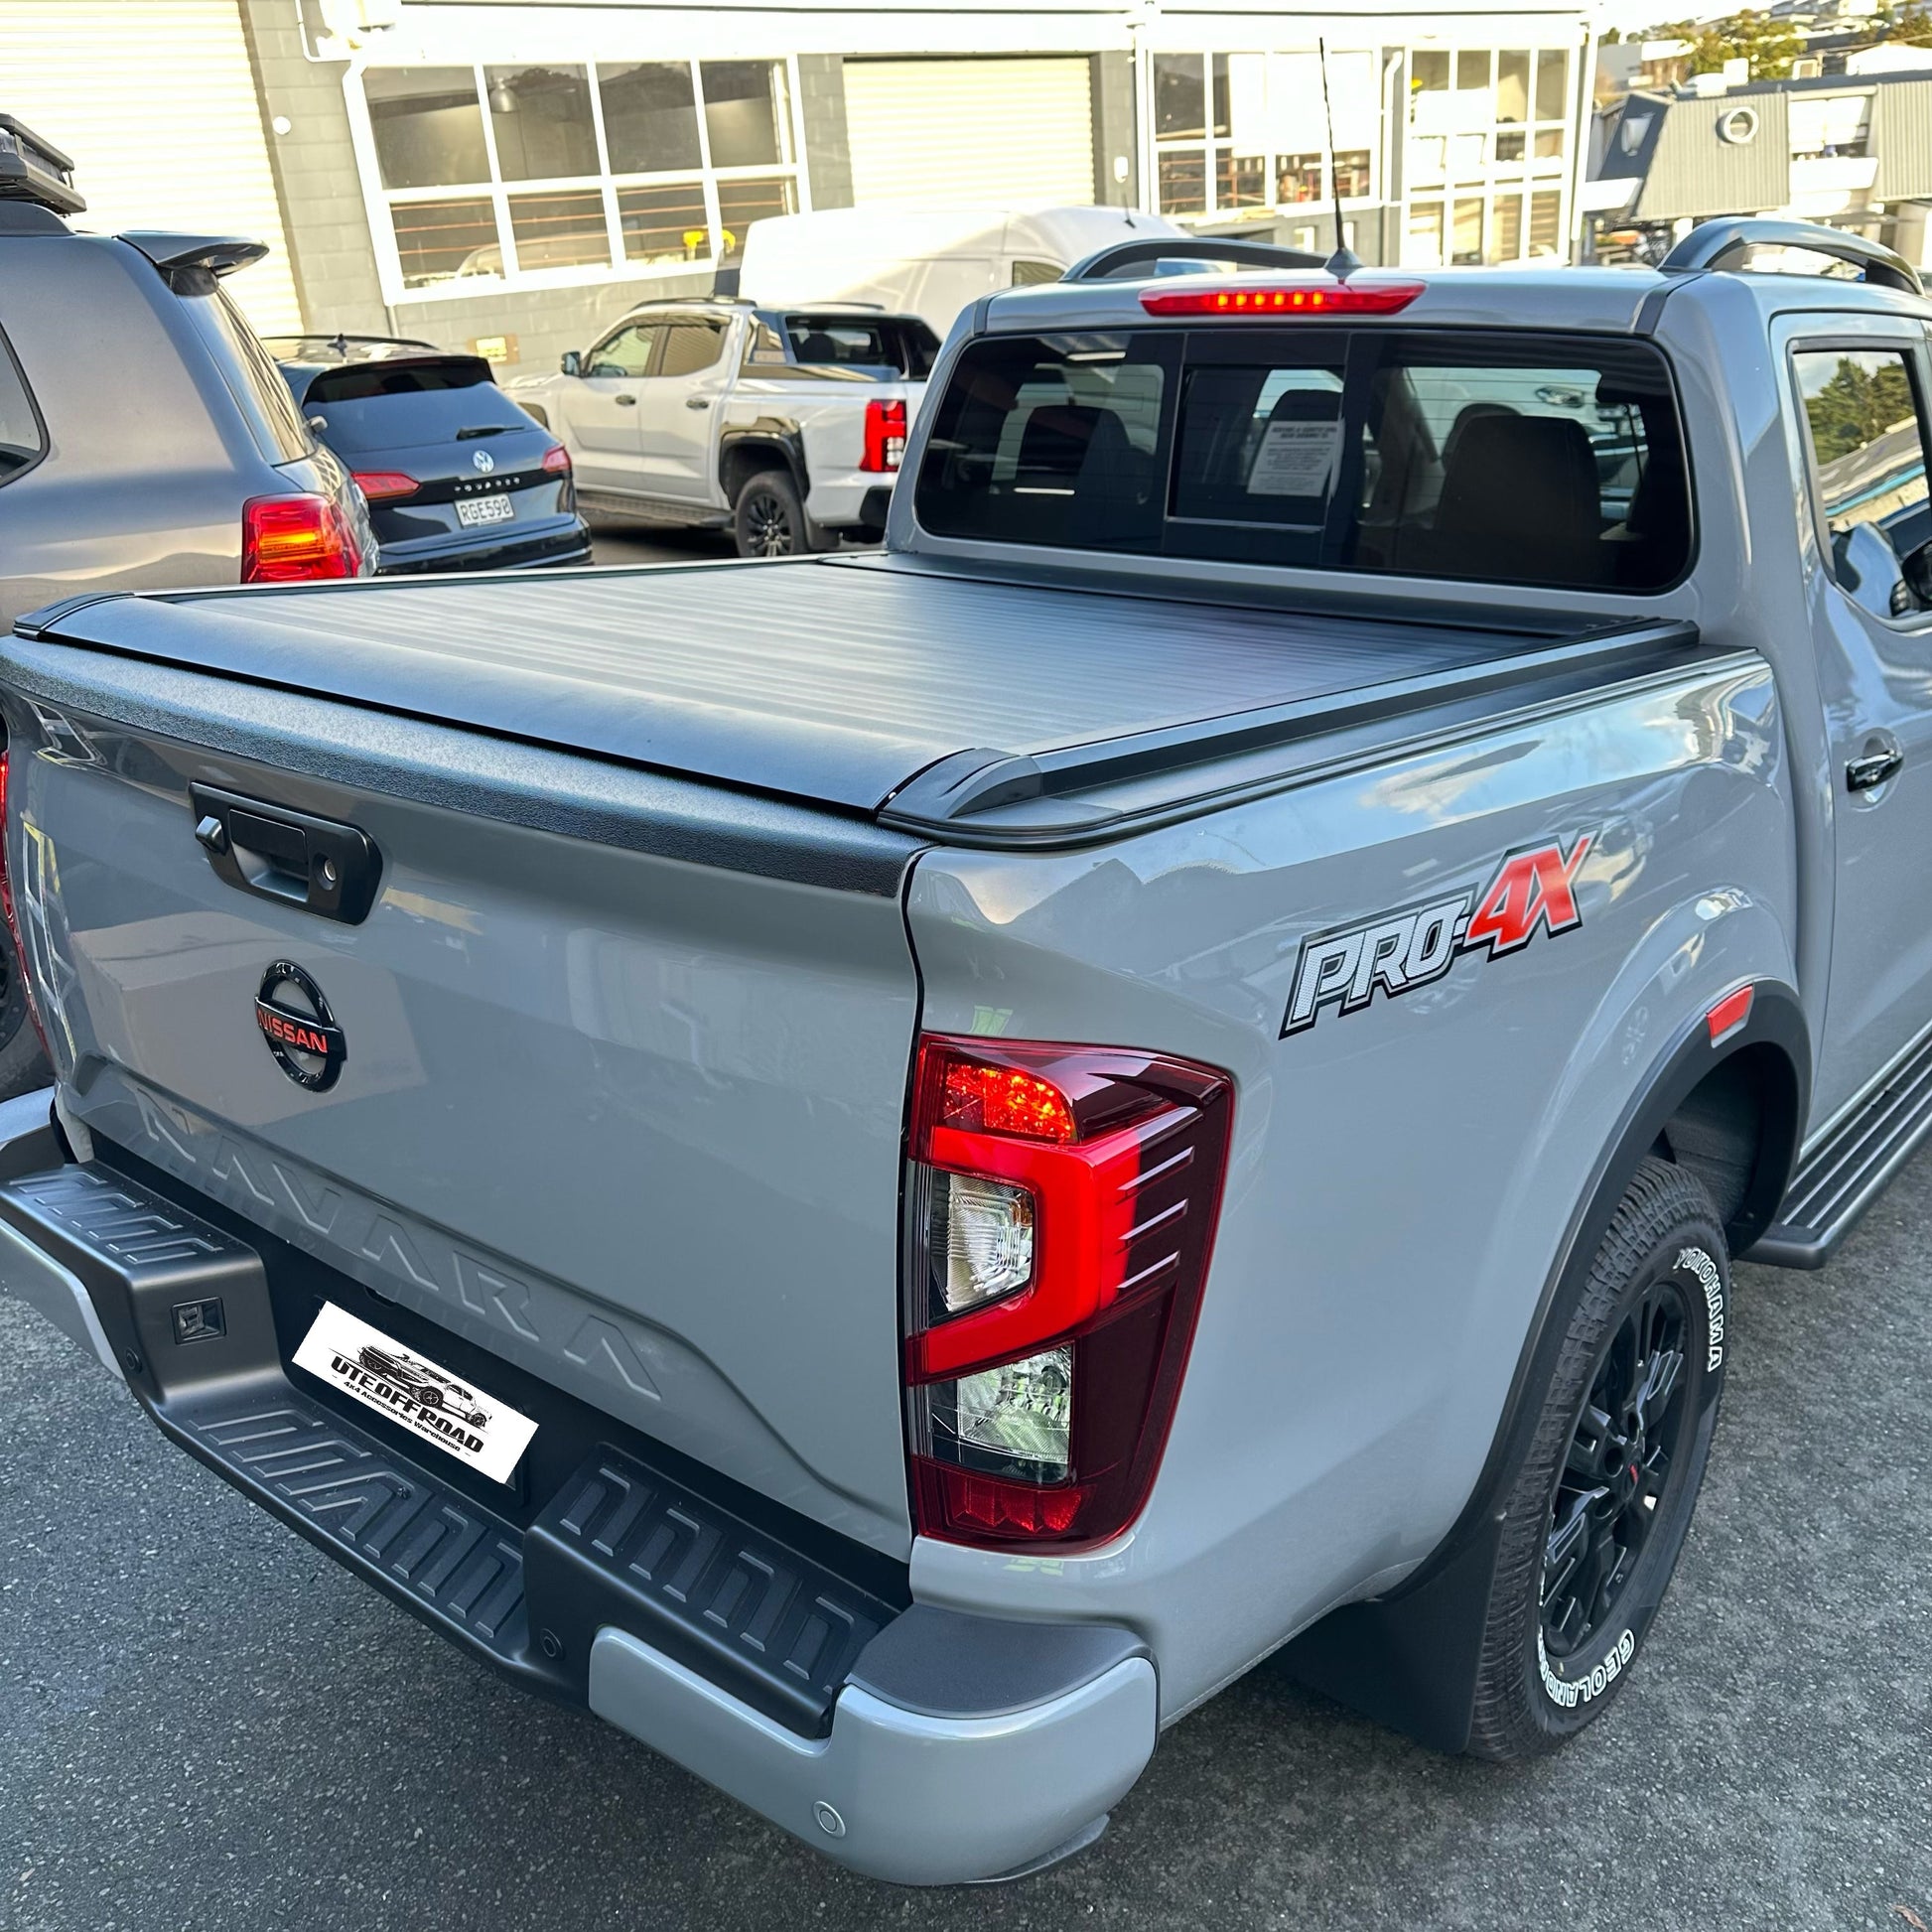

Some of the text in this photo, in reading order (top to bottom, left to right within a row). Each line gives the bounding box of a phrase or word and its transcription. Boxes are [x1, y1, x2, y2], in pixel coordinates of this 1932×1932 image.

[460, 498, 509, 521] RGE590
[1280, 824, 1601, 1039] PRO-4X
[257, 1008, 328, 1053] NISSAN
[137, 1087, 661, 1401] NAVARA
[1673, 1247, 1724, 1372] YOKOHAMA
[1538, 1625, 1635, 1708] GEOLAND
